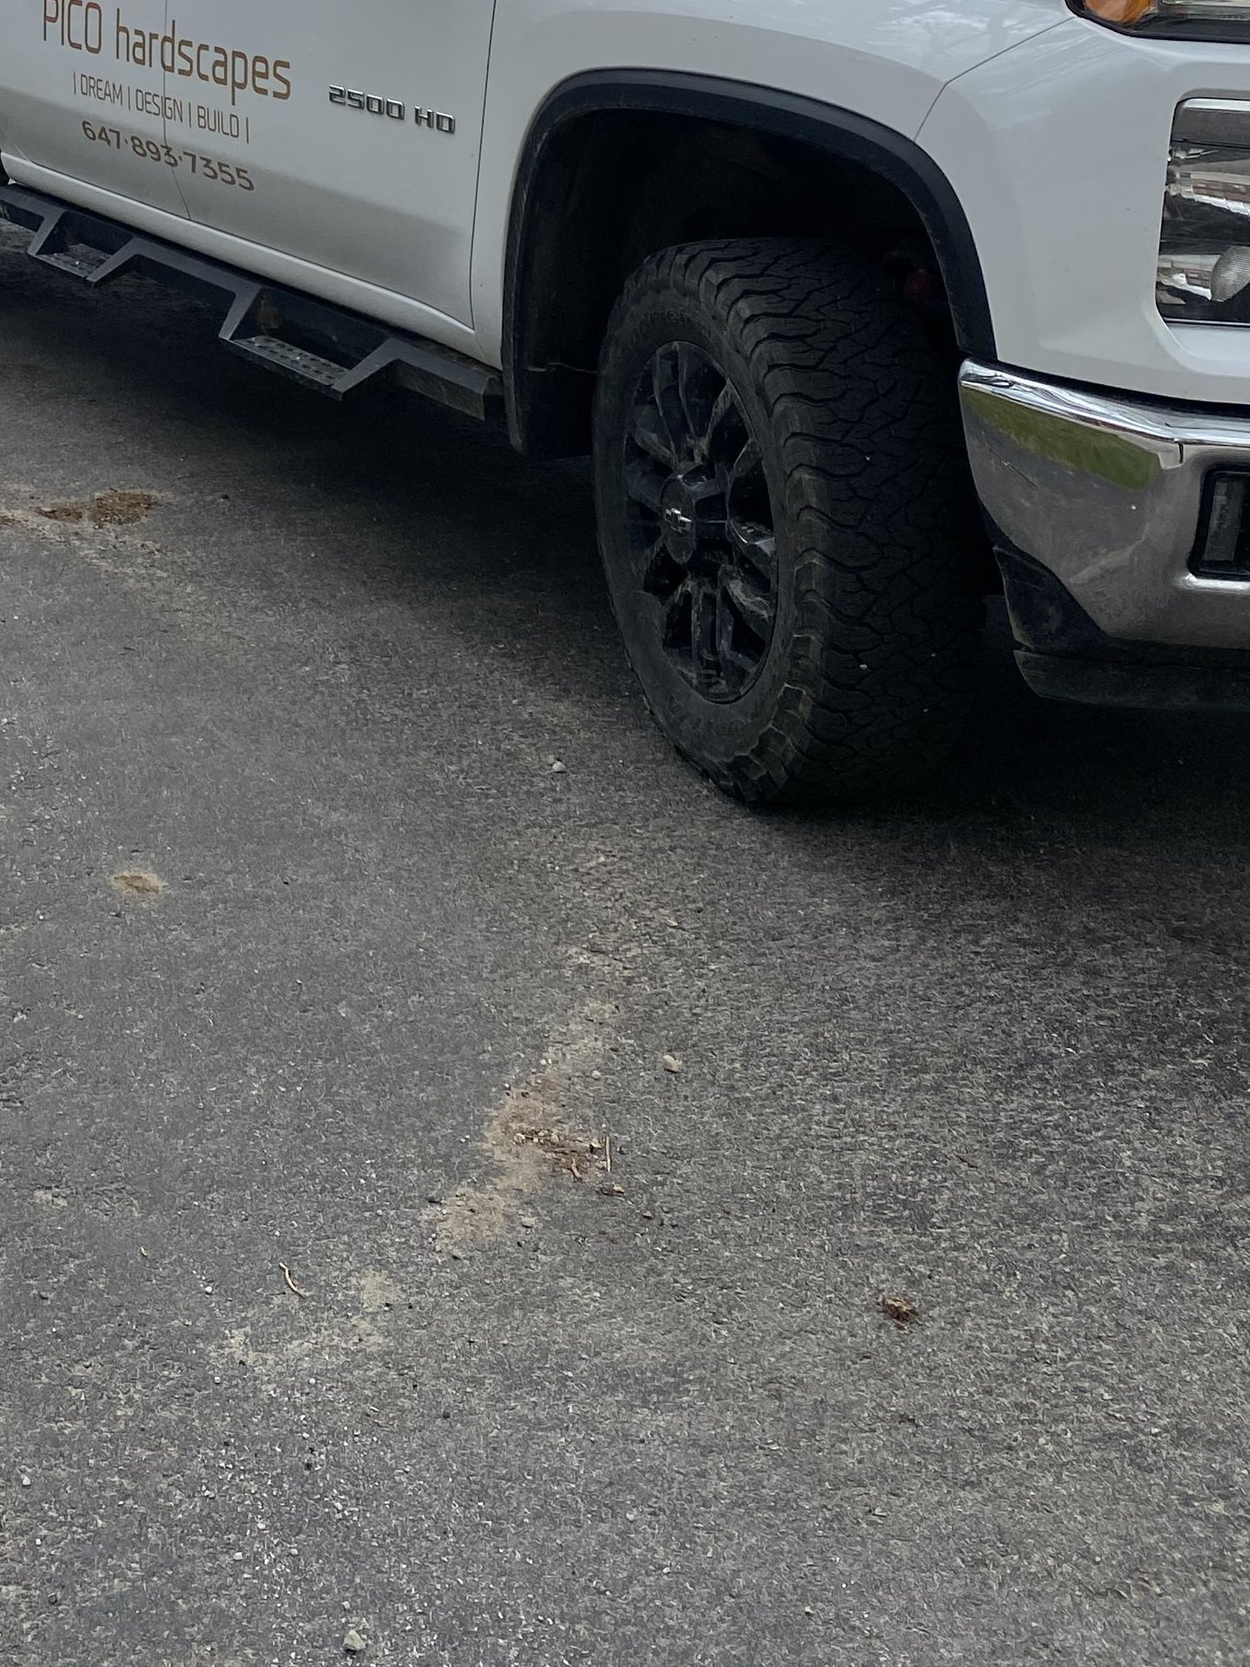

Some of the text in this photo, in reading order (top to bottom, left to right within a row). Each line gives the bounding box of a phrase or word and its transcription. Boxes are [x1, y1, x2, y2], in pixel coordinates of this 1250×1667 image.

[116, 7, 291, 106] hardscapes
[80, 73, 240, 138] DREAM DESIGN BUILD
[329, 84, 456, 135] 2500 HD
